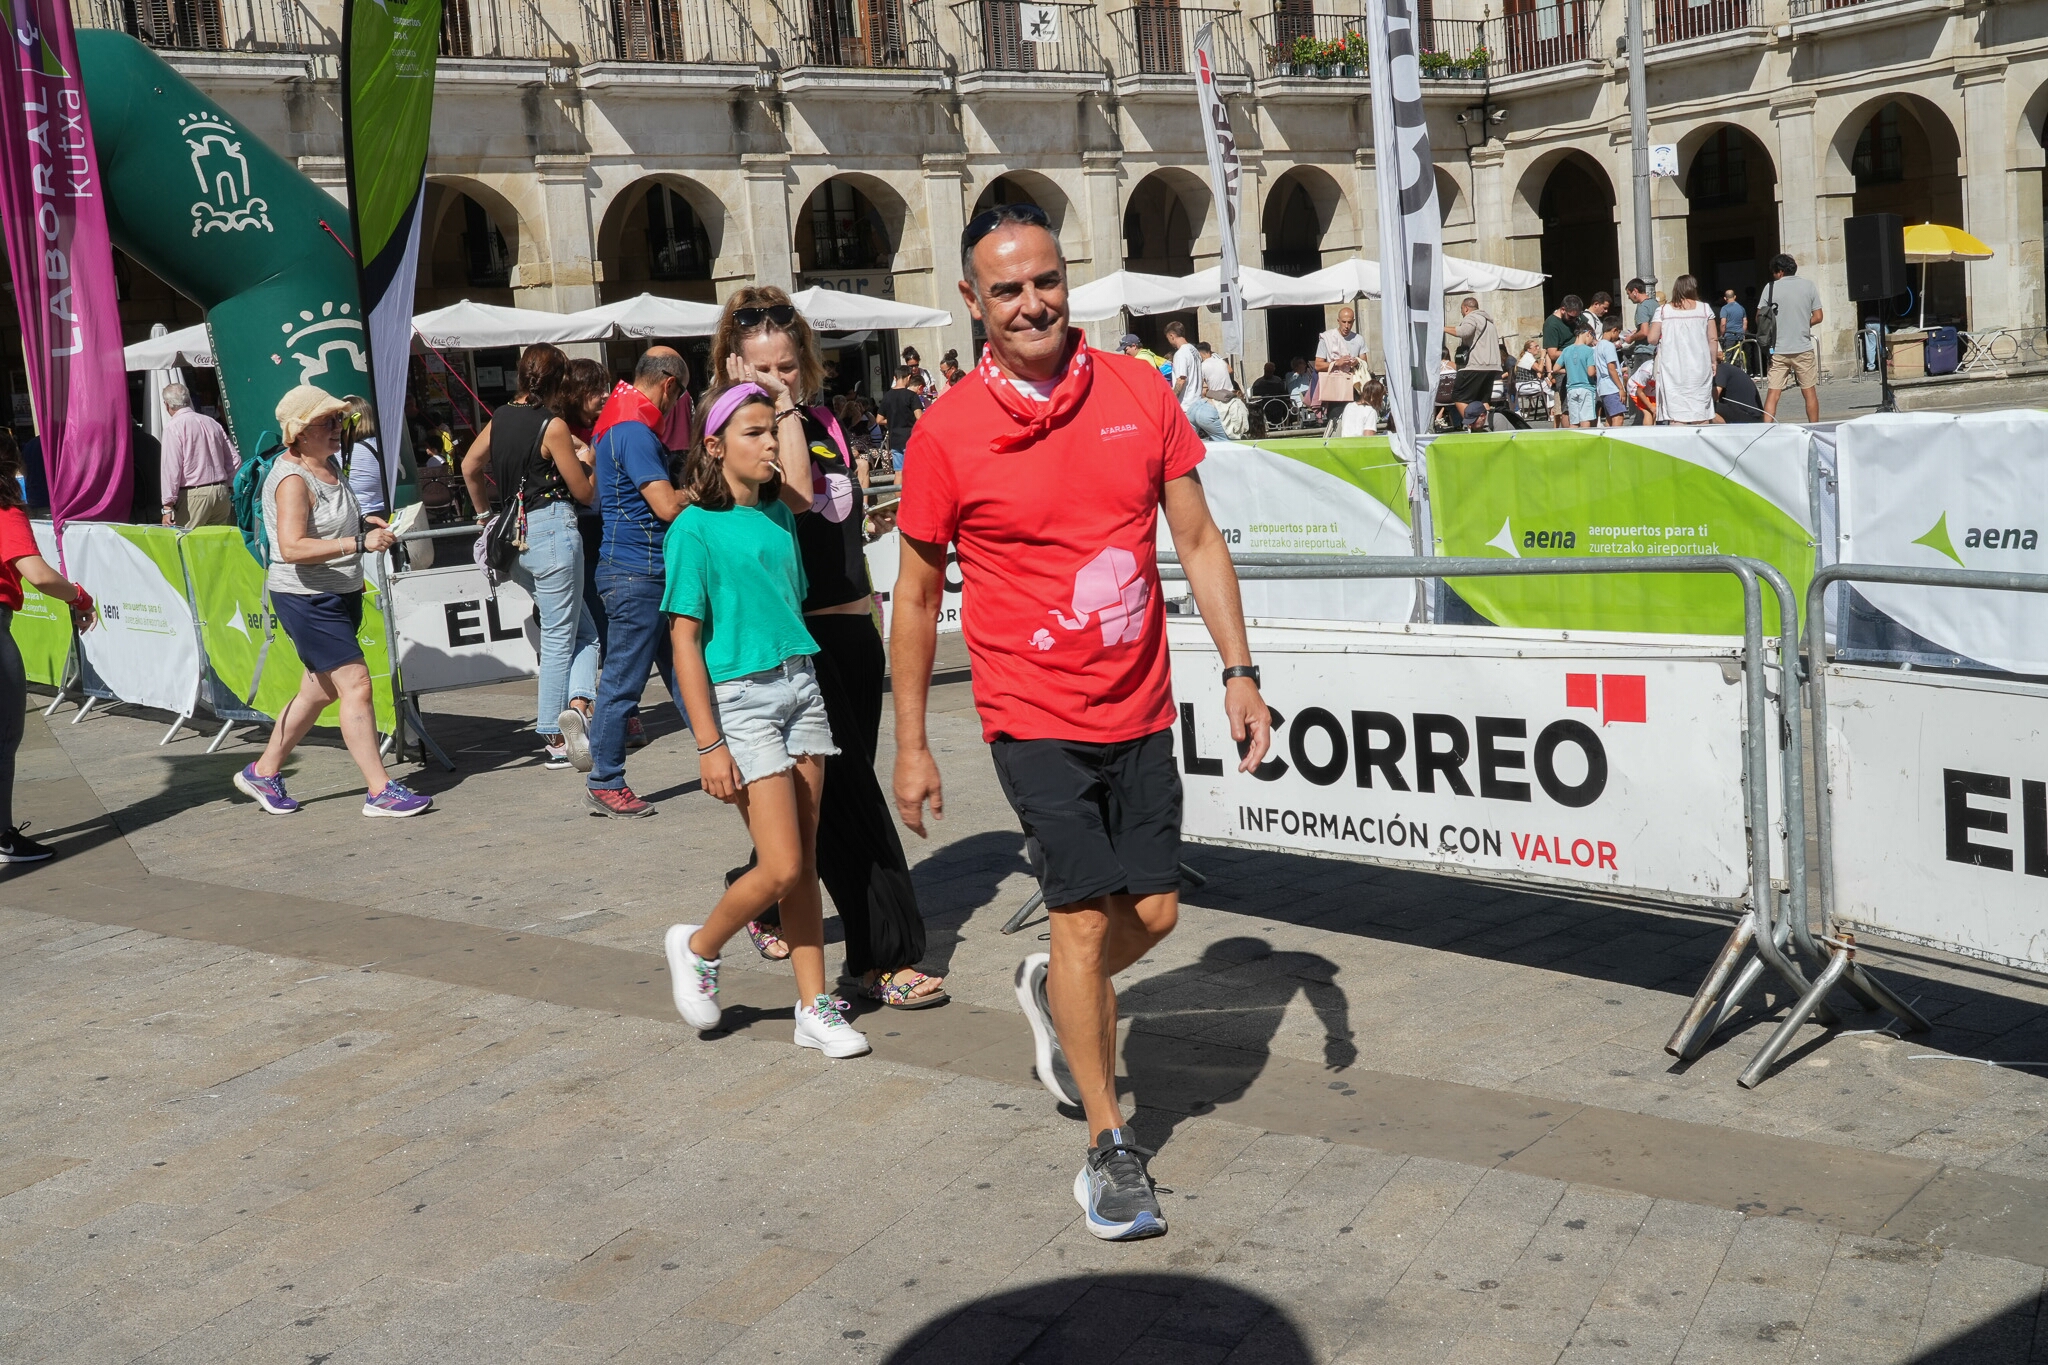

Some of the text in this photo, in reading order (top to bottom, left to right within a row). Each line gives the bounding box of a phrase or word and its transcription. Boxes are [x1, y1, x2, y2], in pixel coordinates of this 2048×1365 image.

[57, 89, 94, 198] kutxa
[23, 86, 84, 359] LABORAL
[1221, 528, 1242, 544] na
[1249, 522, 1338, 535] aeropuertos para ti
[1588, 524, 1709, 540] aeropuertos para ti
[1965, 527, 2039, 551] aena
[1250, 537, 1347, 550] zuretzako aireportuak
[1523, 530, 1576, 549] aena
[1589, 541, 1720, 556] zuretzako aireportuak
[444, 599, 523, 648] EL
[1174, 703, 1608, 808] L CORREO
[1239, 805, 1619, 871] INFORMACIÓN CON VALOR
